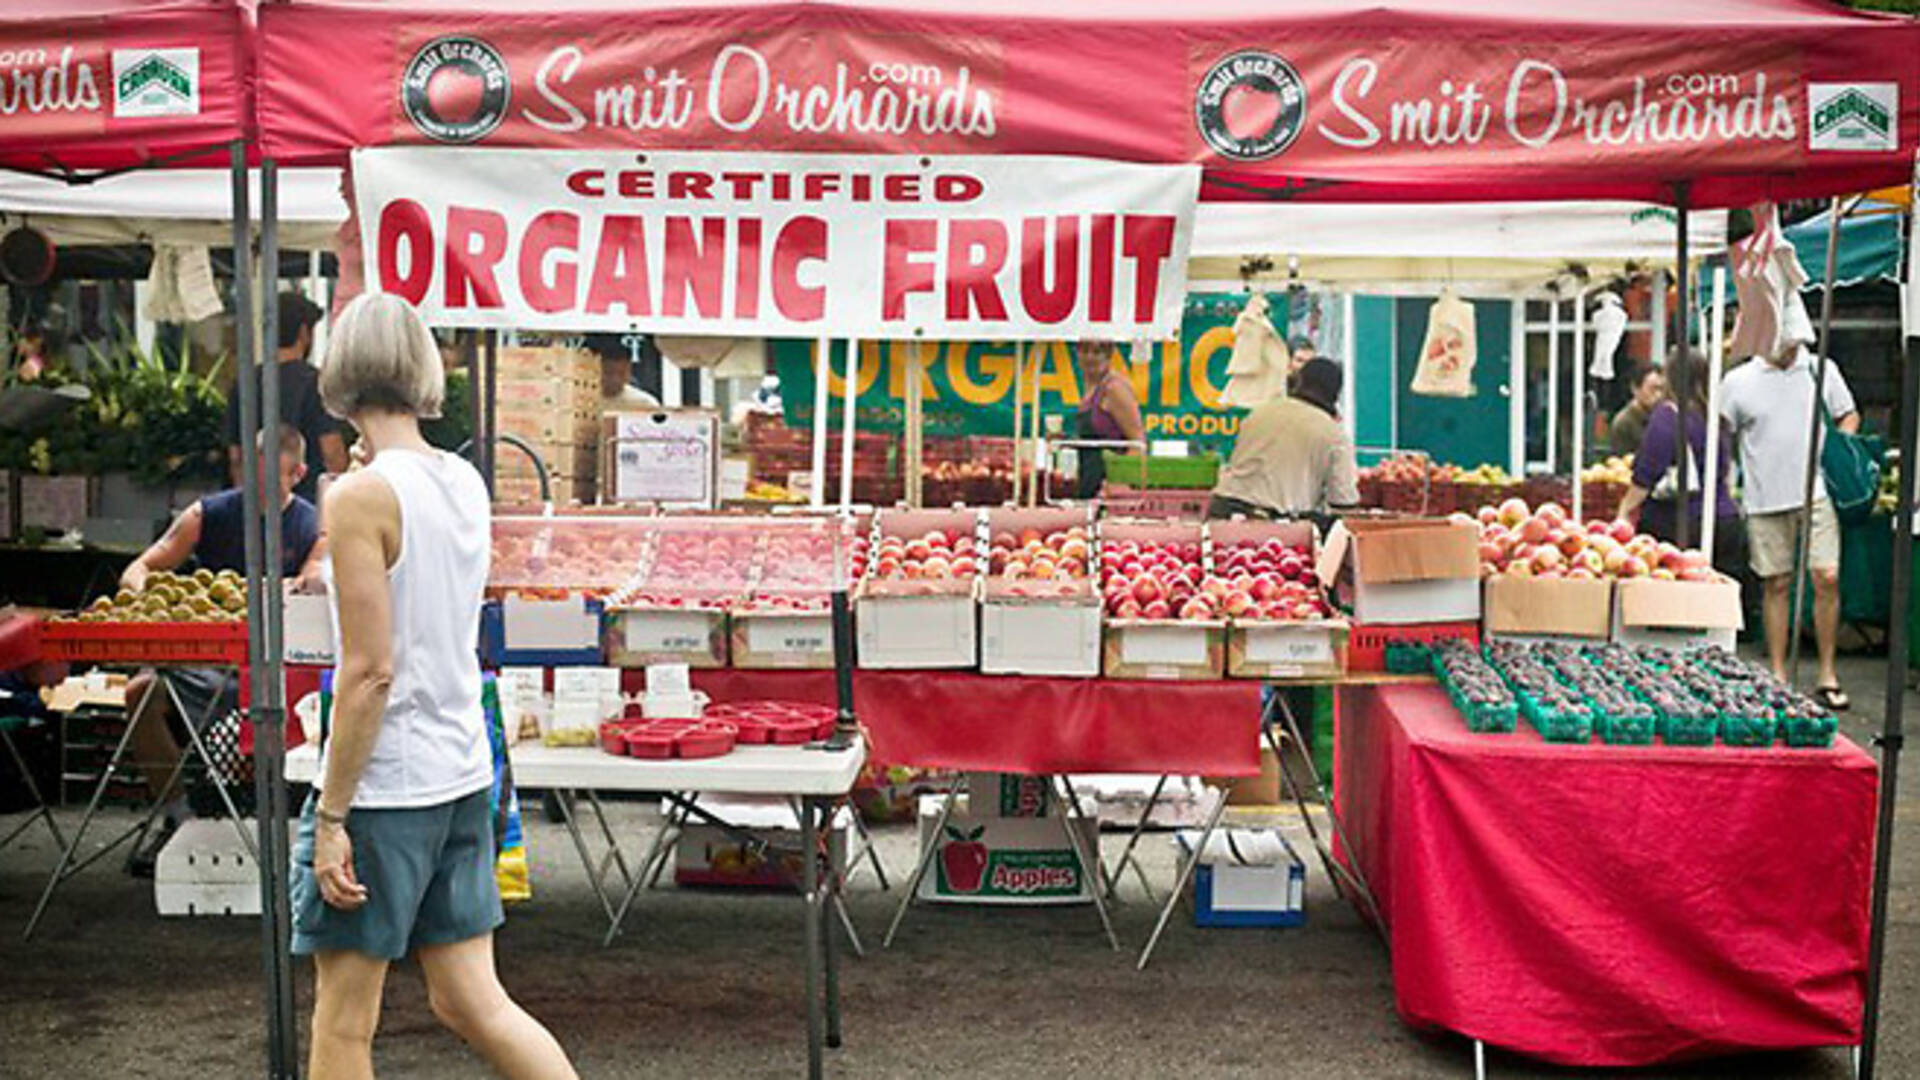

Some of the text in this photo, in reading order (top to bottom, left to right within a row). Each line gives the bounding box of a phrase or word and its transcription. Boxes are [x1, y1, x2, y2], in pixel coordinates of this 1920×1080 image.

[0, 49, 46, 65] om
[860, 62, 941, 84] .com
[0, 46, 100, 114] rds
[521, 43, 997, 137] Smit Orchards
[1658, 73, 1739, 95] .com
[1318, 58, 1796, 148] Smit Orchards
[566, 169, 985, 202] CERTIFIED
[377, 197, 1178, 325] ORGANIC FRUIT
[1145, 413, 1239, 435] PRODU
[991, 863, 1077, 894] Apples
